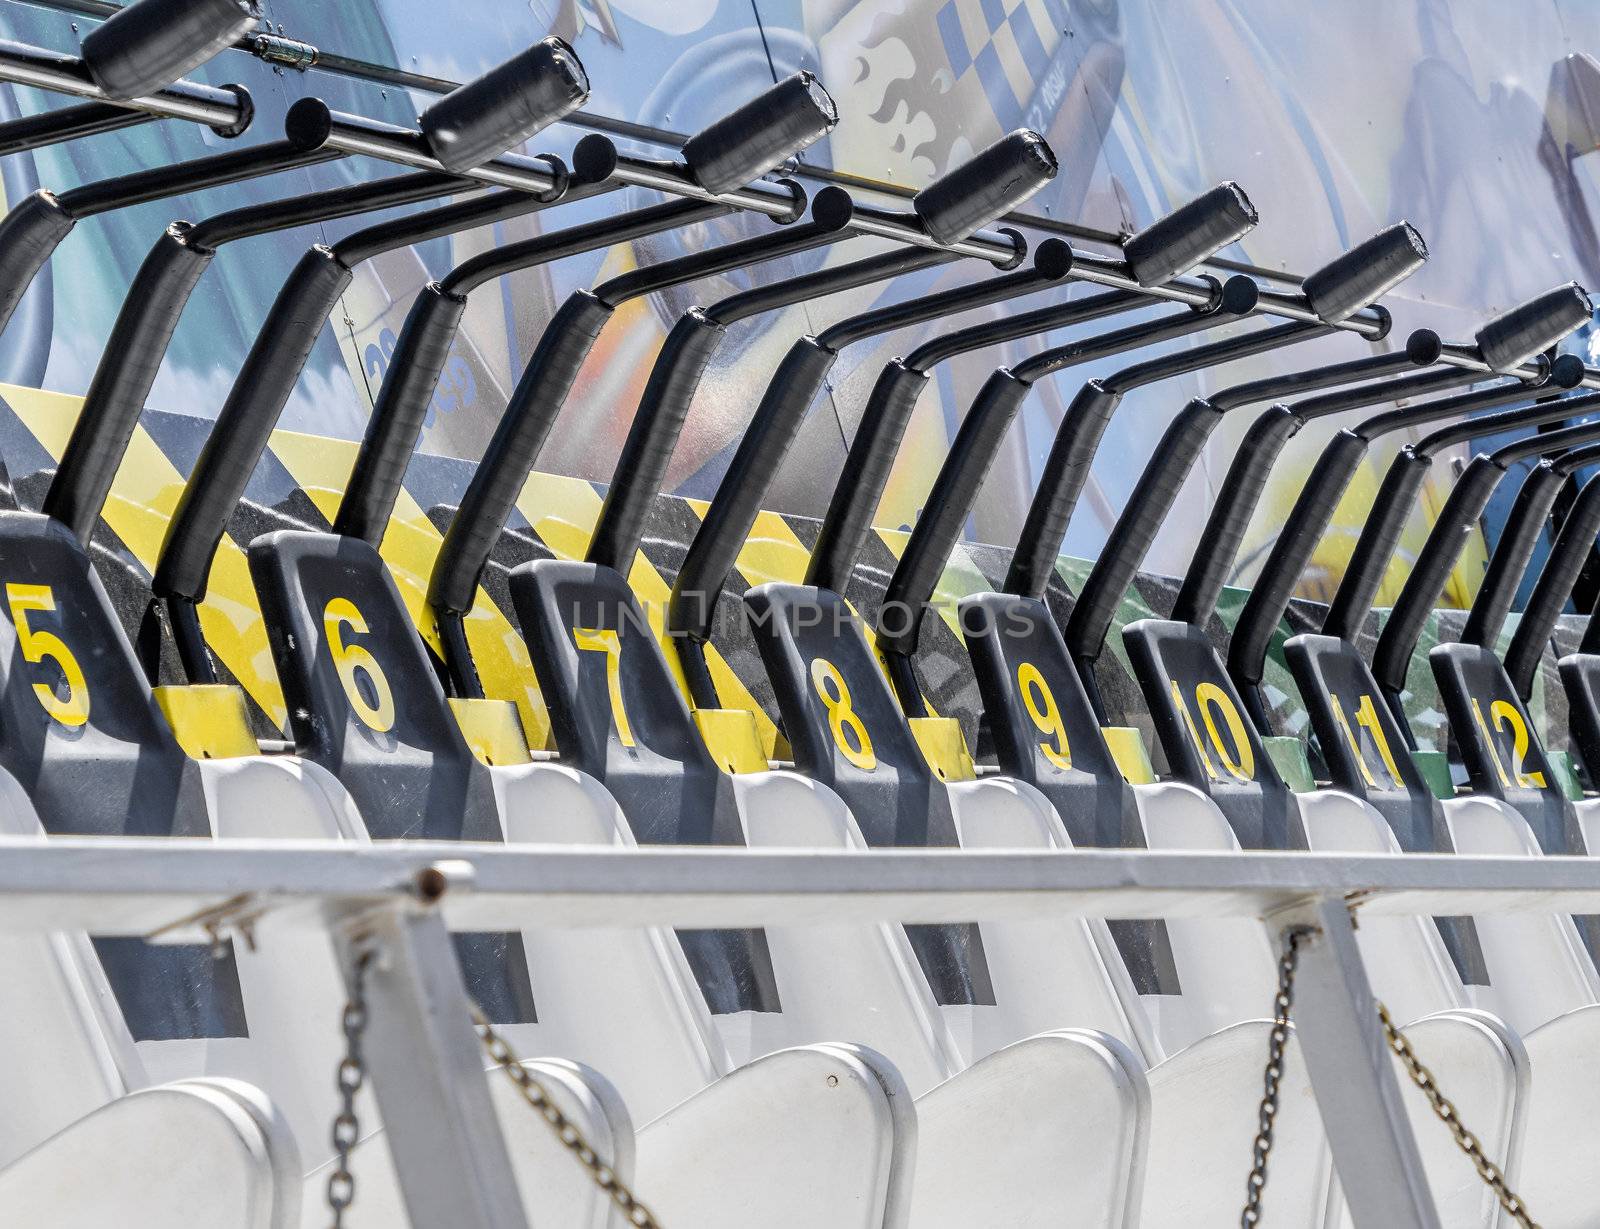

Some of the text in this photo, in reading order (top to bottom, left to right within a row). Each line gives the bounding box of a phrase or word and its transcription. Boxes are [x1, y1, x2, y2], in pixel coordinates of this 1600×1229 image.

[6, 583, 90, 727] 5
[323, 597, 395, 732] 6
[573, 627, 635, 748] 7
[811, 658, 877, 771] 8
[1017, 662, 1073, 771] 9
[1171, 680, 1255, 782] 10
[1331, 694, 1405, 788] 11
[1471, 697, 1548, 789] 12
